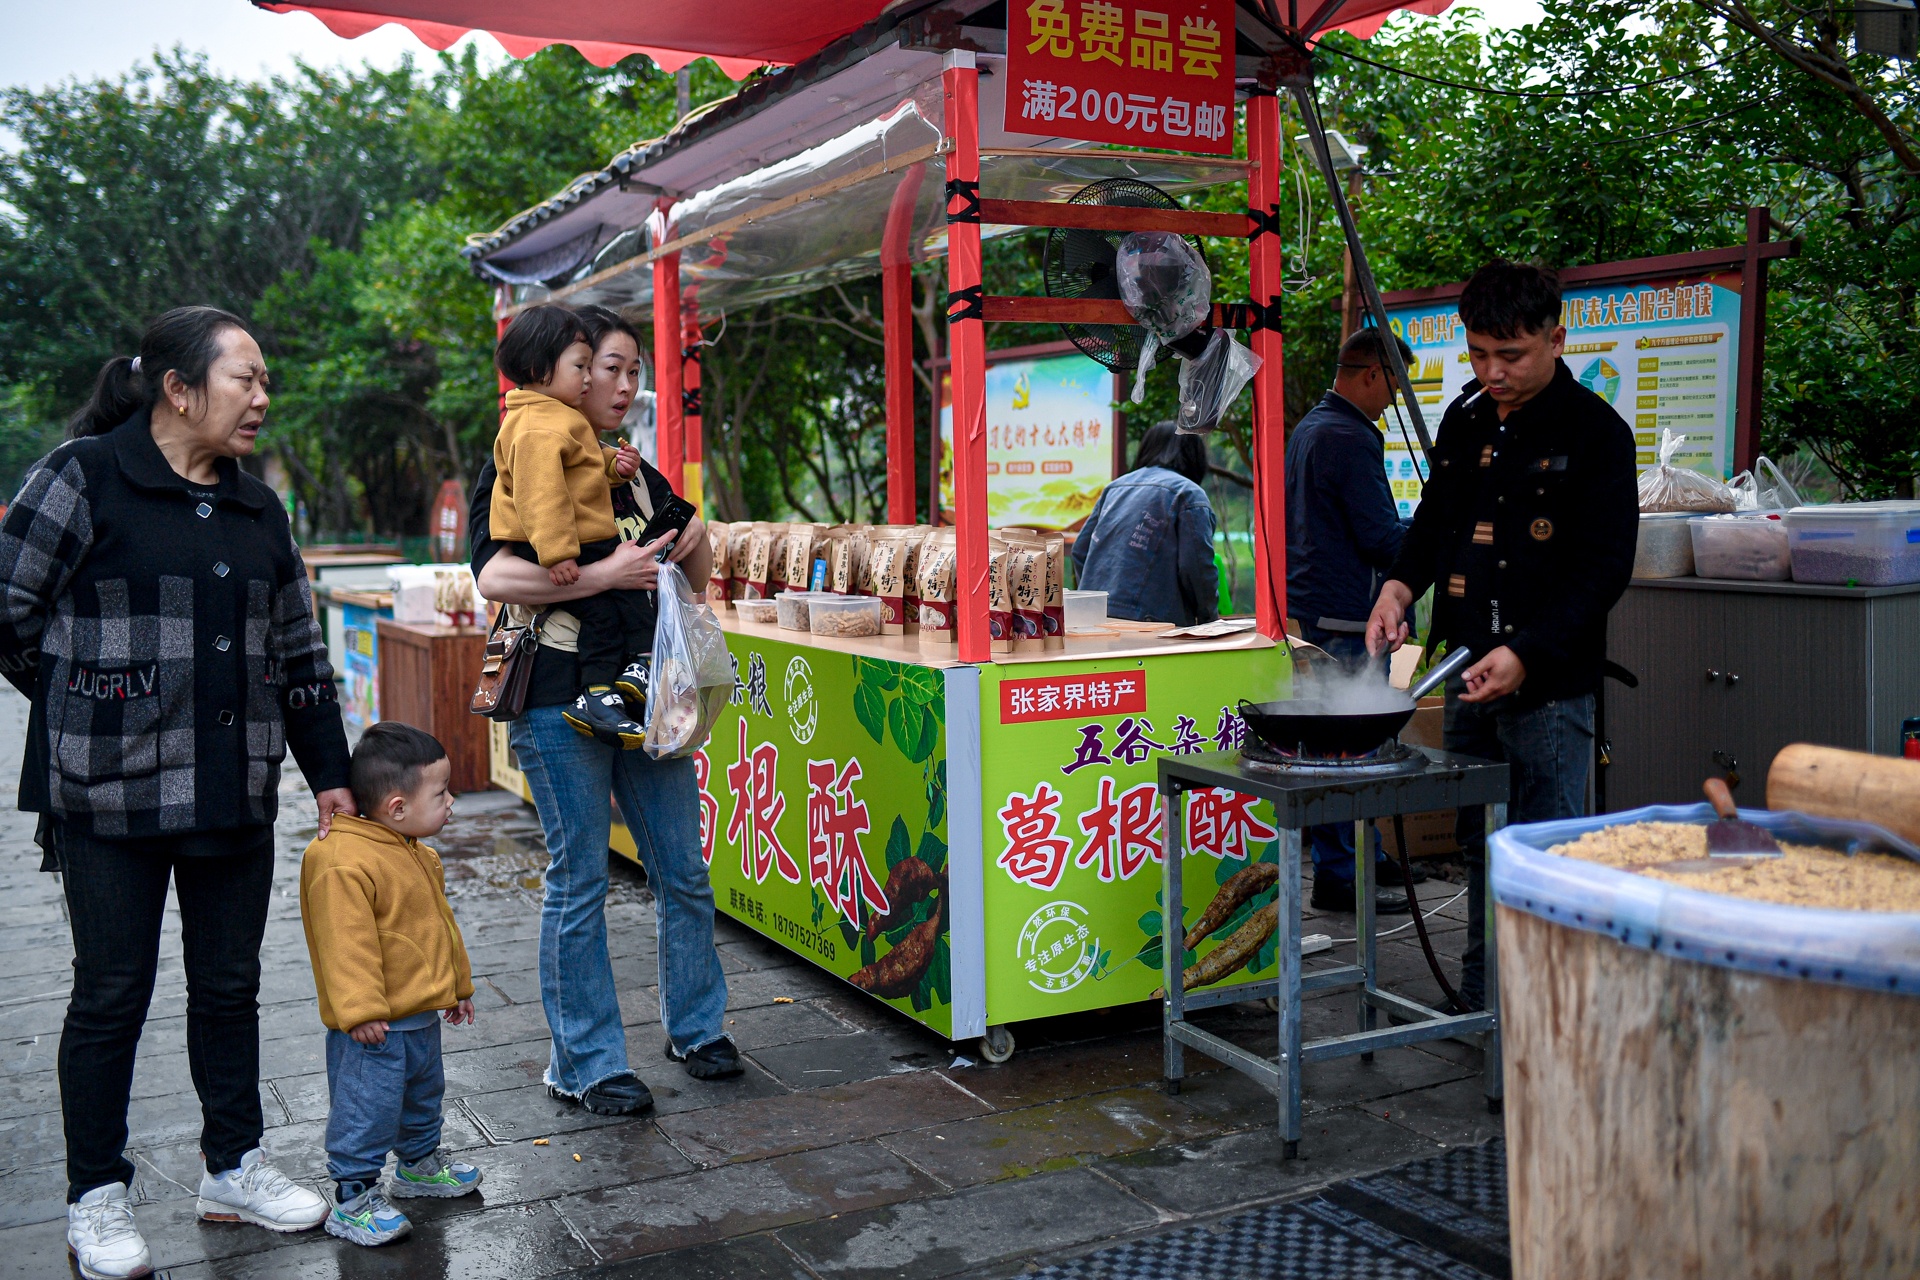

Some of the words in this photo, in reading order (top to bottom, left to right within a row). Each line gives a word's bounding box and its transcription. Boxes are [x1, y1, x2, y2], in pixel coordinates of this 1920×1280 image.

[1025, 0, 1222, 80] 免费品尝
[1021, 79, 1227, 142] 满200元包邮
[1010, 678, 1136, 715] 张家界特产
[997, 775, 1280, 891] 葛根酥
[1024, 906, 1070, 941] 天然环保
[1025, 924, 1089, 973] 专注原生态
